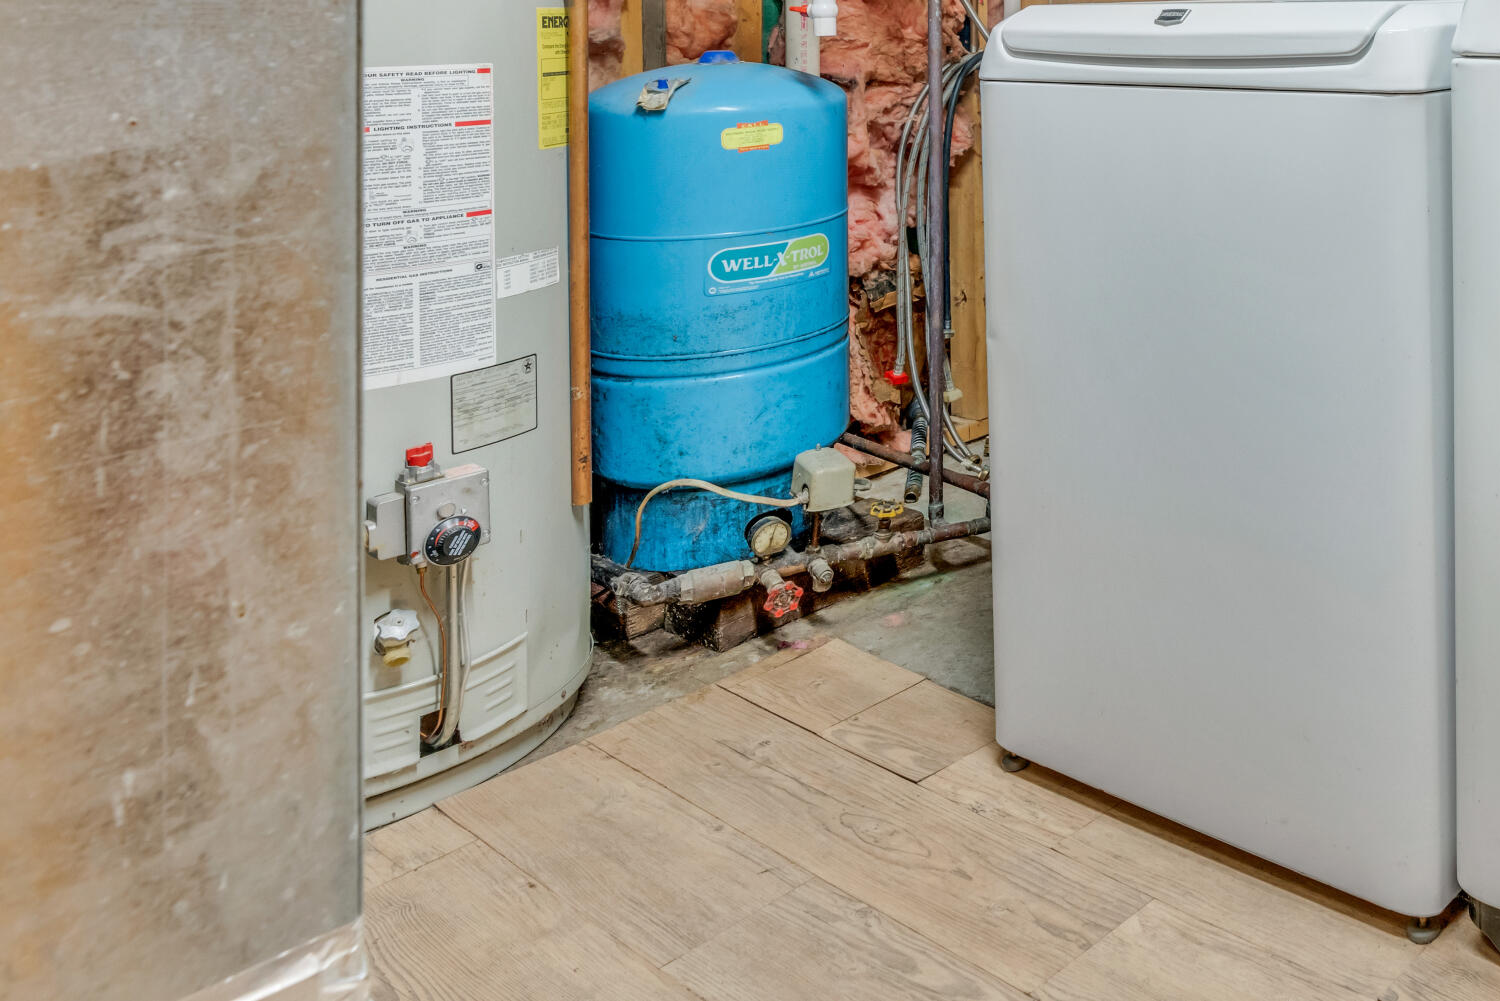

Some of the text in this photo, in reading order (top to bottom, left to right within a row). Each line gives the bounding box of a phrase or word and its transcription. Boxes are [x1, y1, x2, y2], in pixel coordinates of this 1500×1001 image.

[541, 15, 569, 29] ENERG
[431, 213, 464, 221] APPLIANCE
[721, 244, 824, 273] WELL-X-TROL
